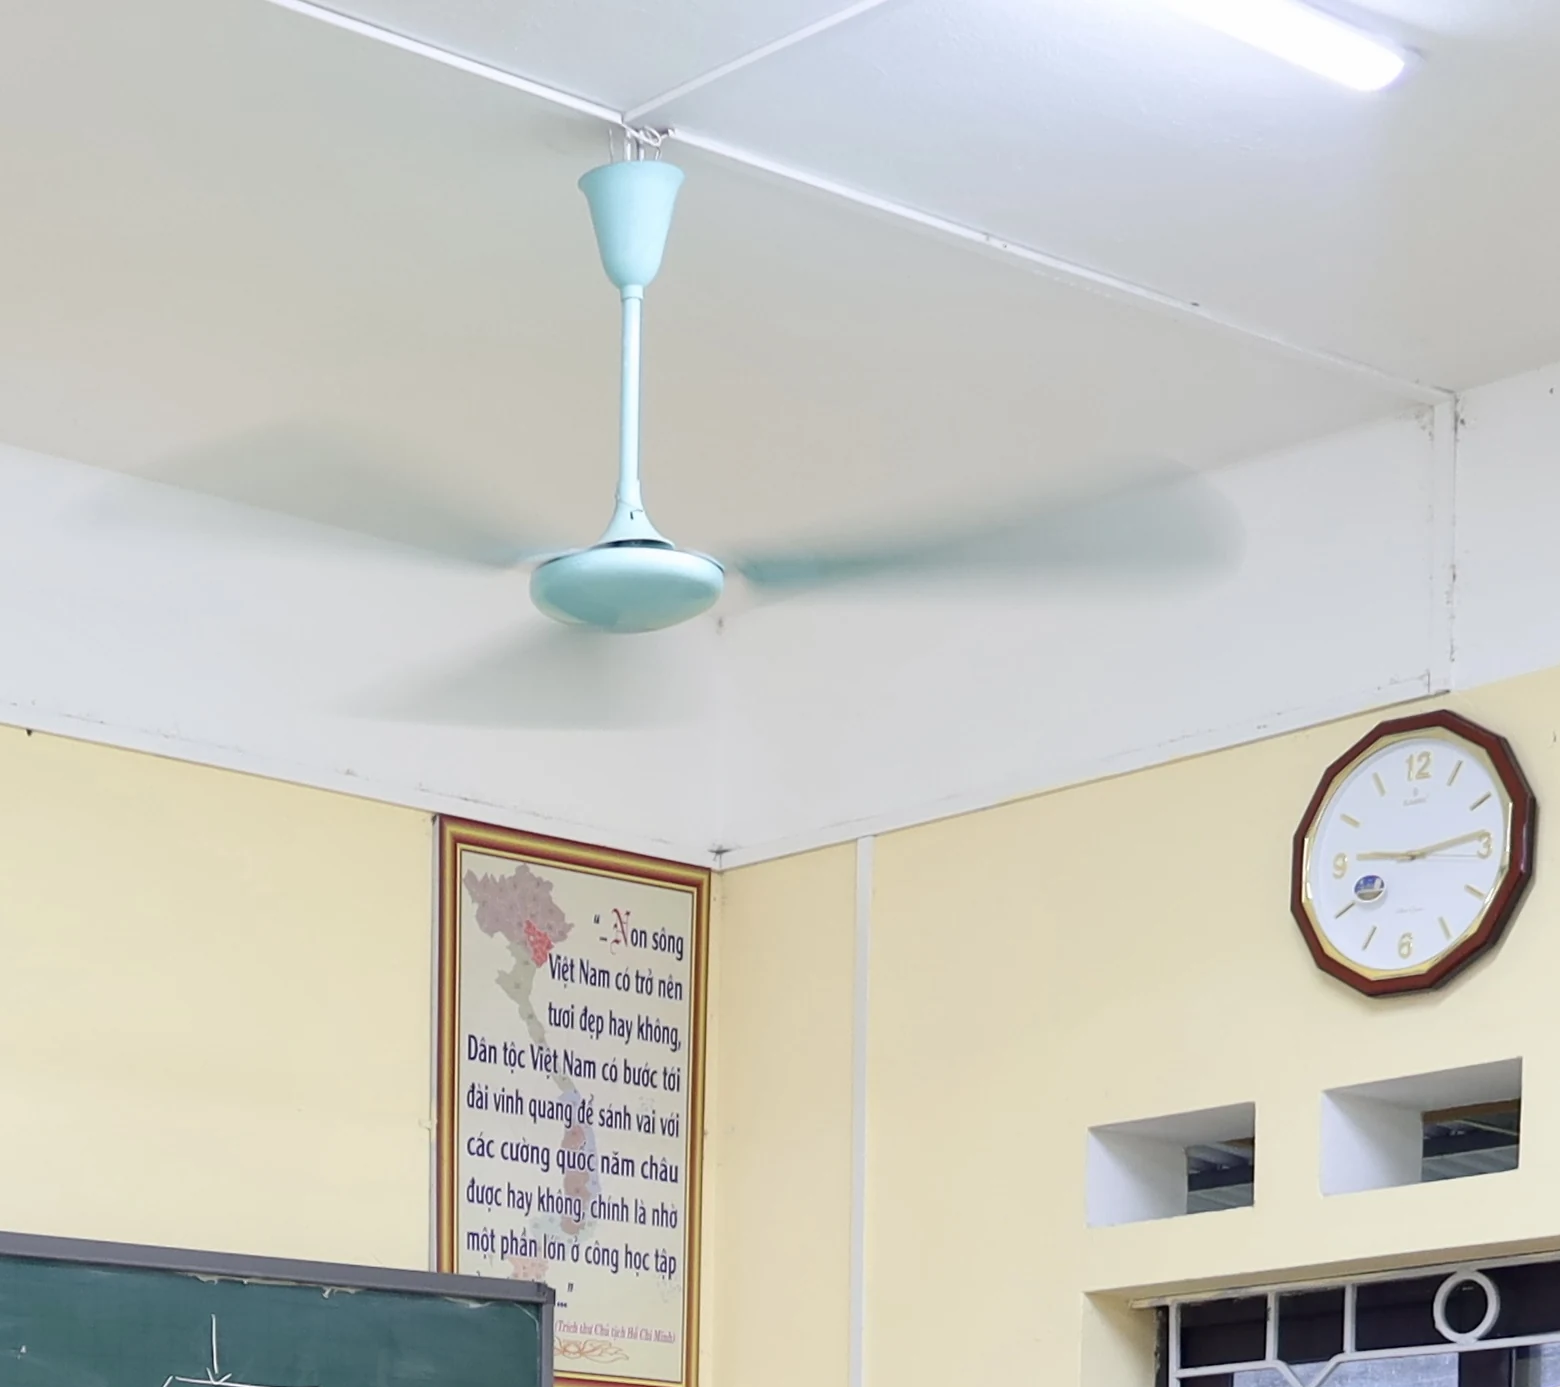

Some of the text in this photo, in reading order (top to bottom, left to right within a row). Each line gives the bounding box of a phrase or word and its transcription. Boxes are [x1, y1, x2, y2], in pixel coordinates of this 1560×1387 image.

[1405, 751, 1432, 781] 12
[1332, 852, 1348, 880] 9
[1477, 830, 1493, 859] 3
[652, 926, 684, 961] sông
[1397, 932, 1414, 959] 6
[548, 952, 683, 1001] Việt Nam có trở nên
[548, 1002, 681, 1053] tươi đẹp hay không,
[467, 1034, 681, 1093] Dân tộc Việt Nam có bước tới
[467, 1083, 679, 1138] đài vinh quang để sánh vai với
[467, 1131, 679, 1184] các cường quốc năm châu
[467, 1177, 678, 1229] được hay không, chính là nhờ
[467, 1227, 677, 1280] một phần lớn ở công học tập
